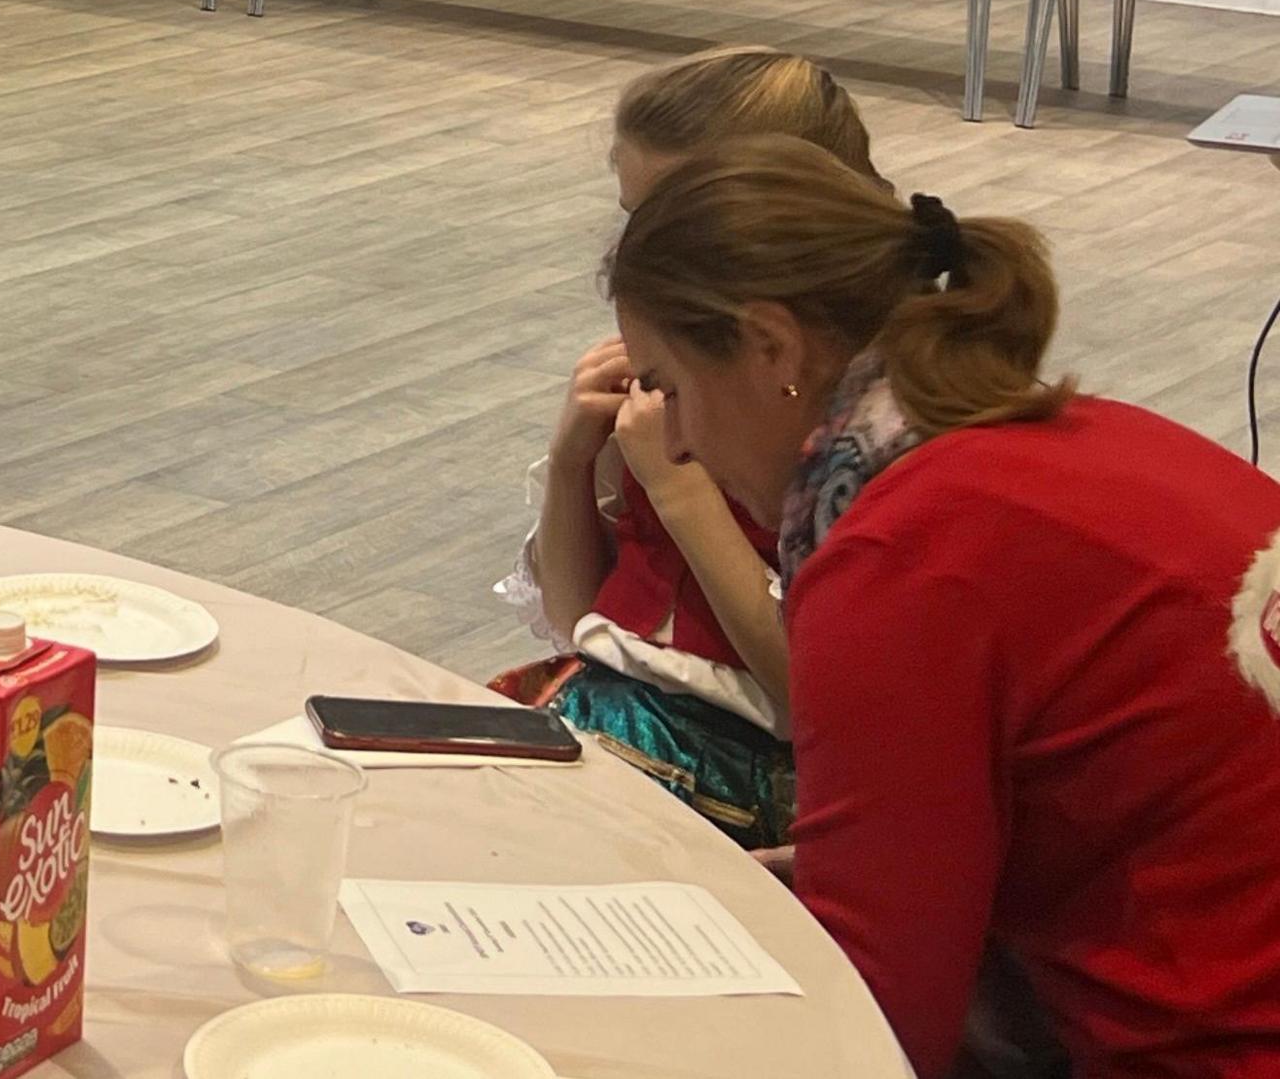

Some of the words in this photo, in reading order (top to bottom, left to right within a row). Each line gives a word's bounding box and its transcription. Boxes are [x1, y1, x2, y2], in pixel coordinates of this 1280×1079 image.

[0, 811, 85, 921] exotic
[19, 792, 72, 870] Sun
[2, 987, 51, 1024] Tropical
[53, 954, 79, 1000] Fruit
